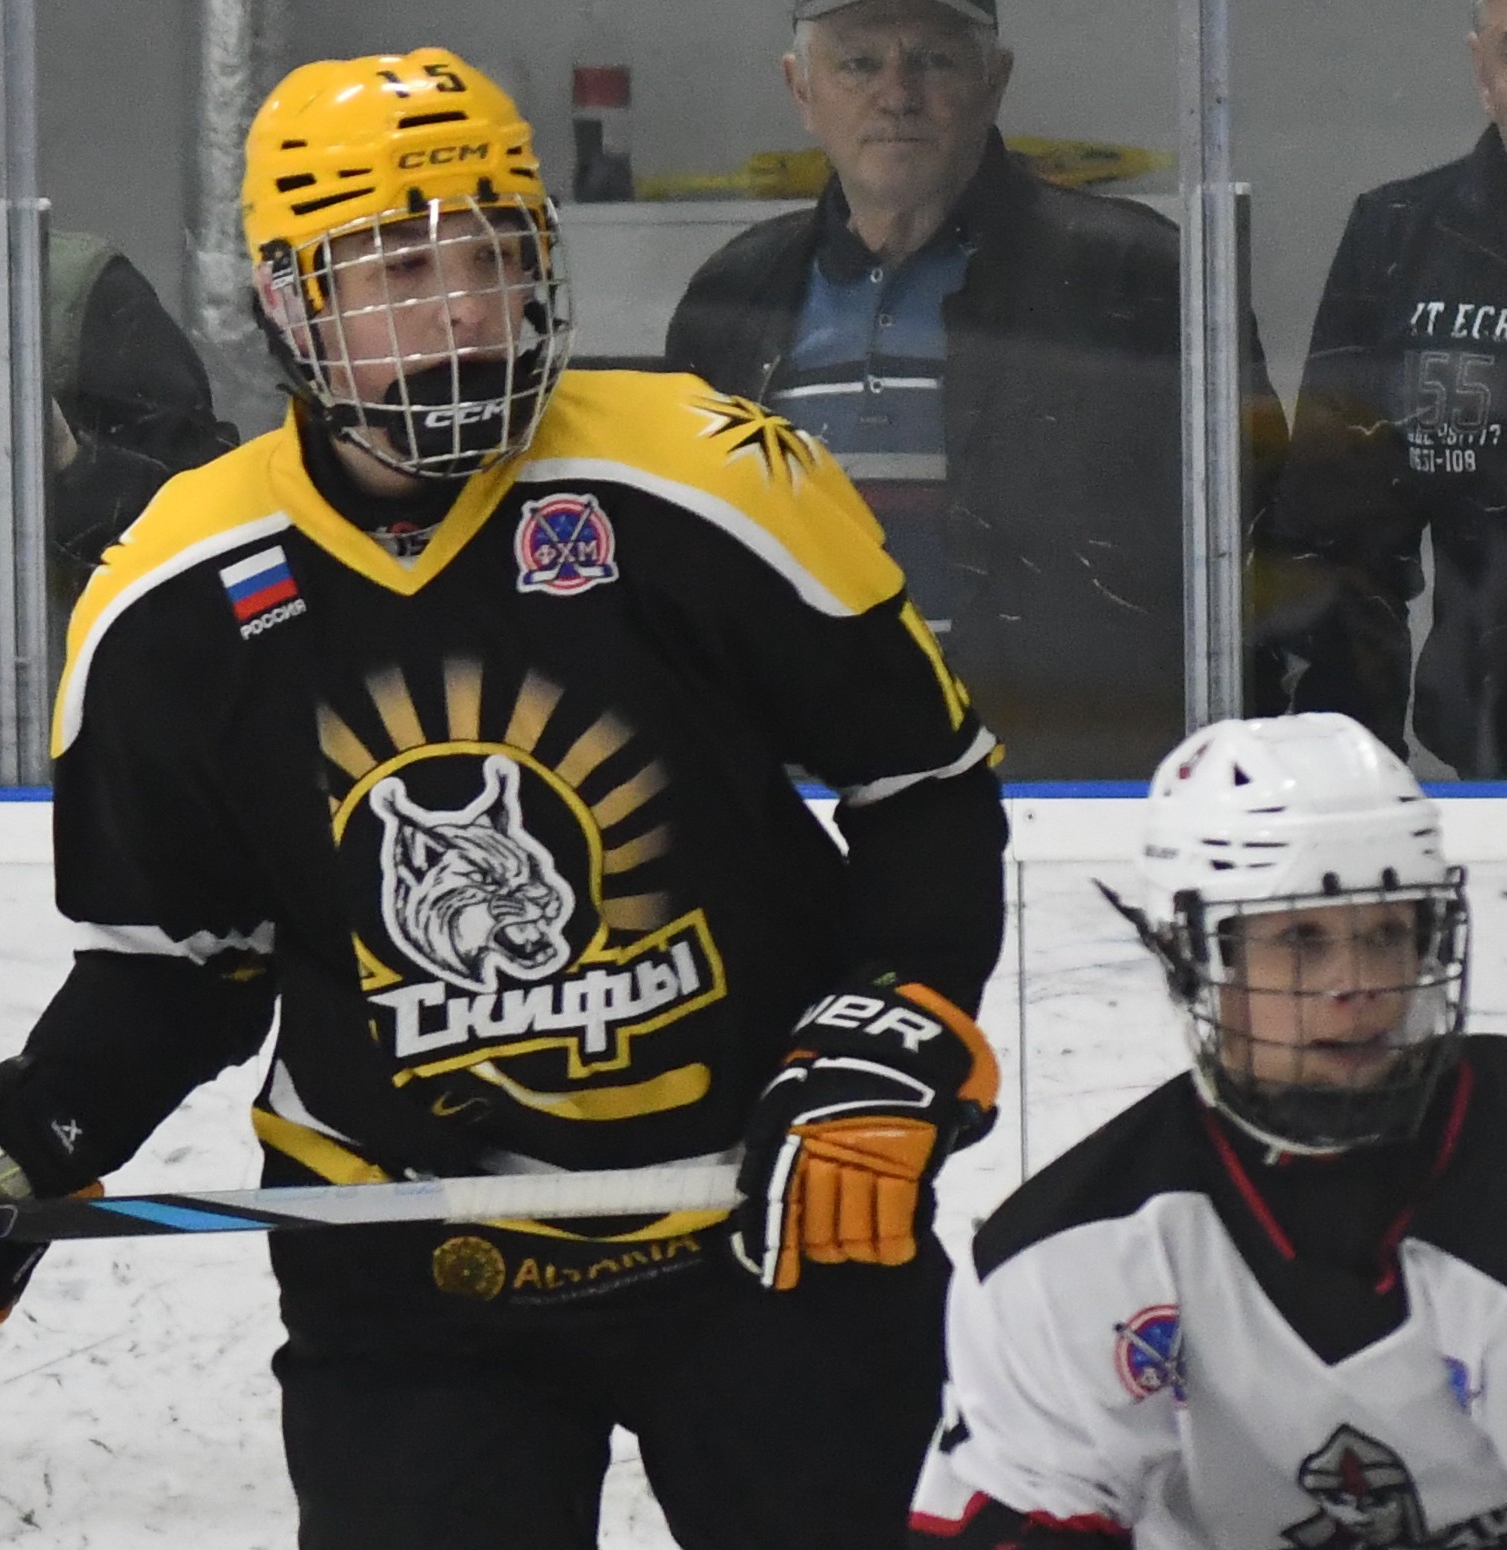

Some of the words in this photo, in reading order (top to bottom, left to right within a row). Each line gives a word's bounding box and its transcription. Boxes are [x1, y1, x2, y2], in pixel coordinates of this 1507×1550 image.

[398, 143, 490, 170] CCM
[534, 540, 598, 566] ФХМ
[239, 598, 308, 641] РОССИЯ
